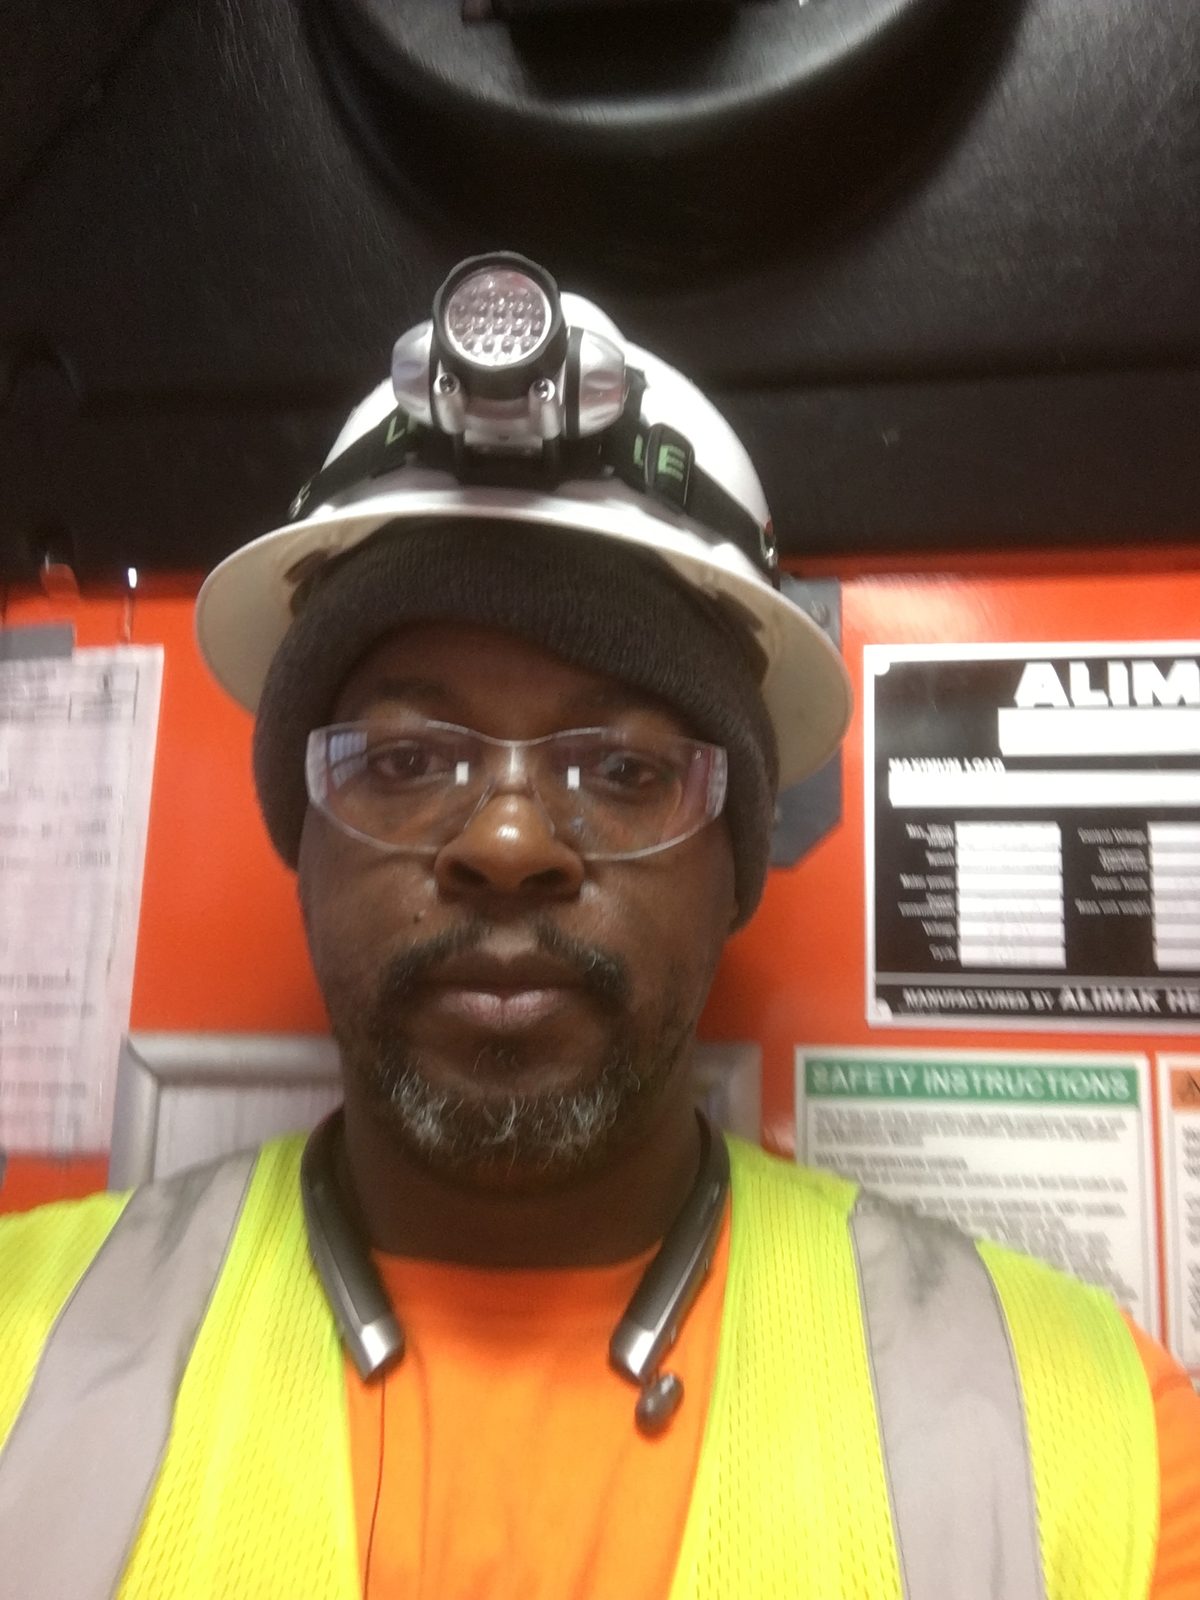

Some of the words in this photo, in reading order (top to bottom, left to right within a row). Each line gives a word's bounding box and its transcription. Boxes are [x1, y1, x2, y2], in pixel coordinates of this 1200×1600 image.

[1013, 659, 1200, 708] ALIM
[902, 985, 1029, 1010] MANUFACTURED
[1030, 988, 1054, 1011] BY
[1058, 984, 1161, 1013] ALIMAK
[812, 1063, 915, 1094] SAFETY
[922, 1065, 1130, 1099] INSTRUCTIONS
